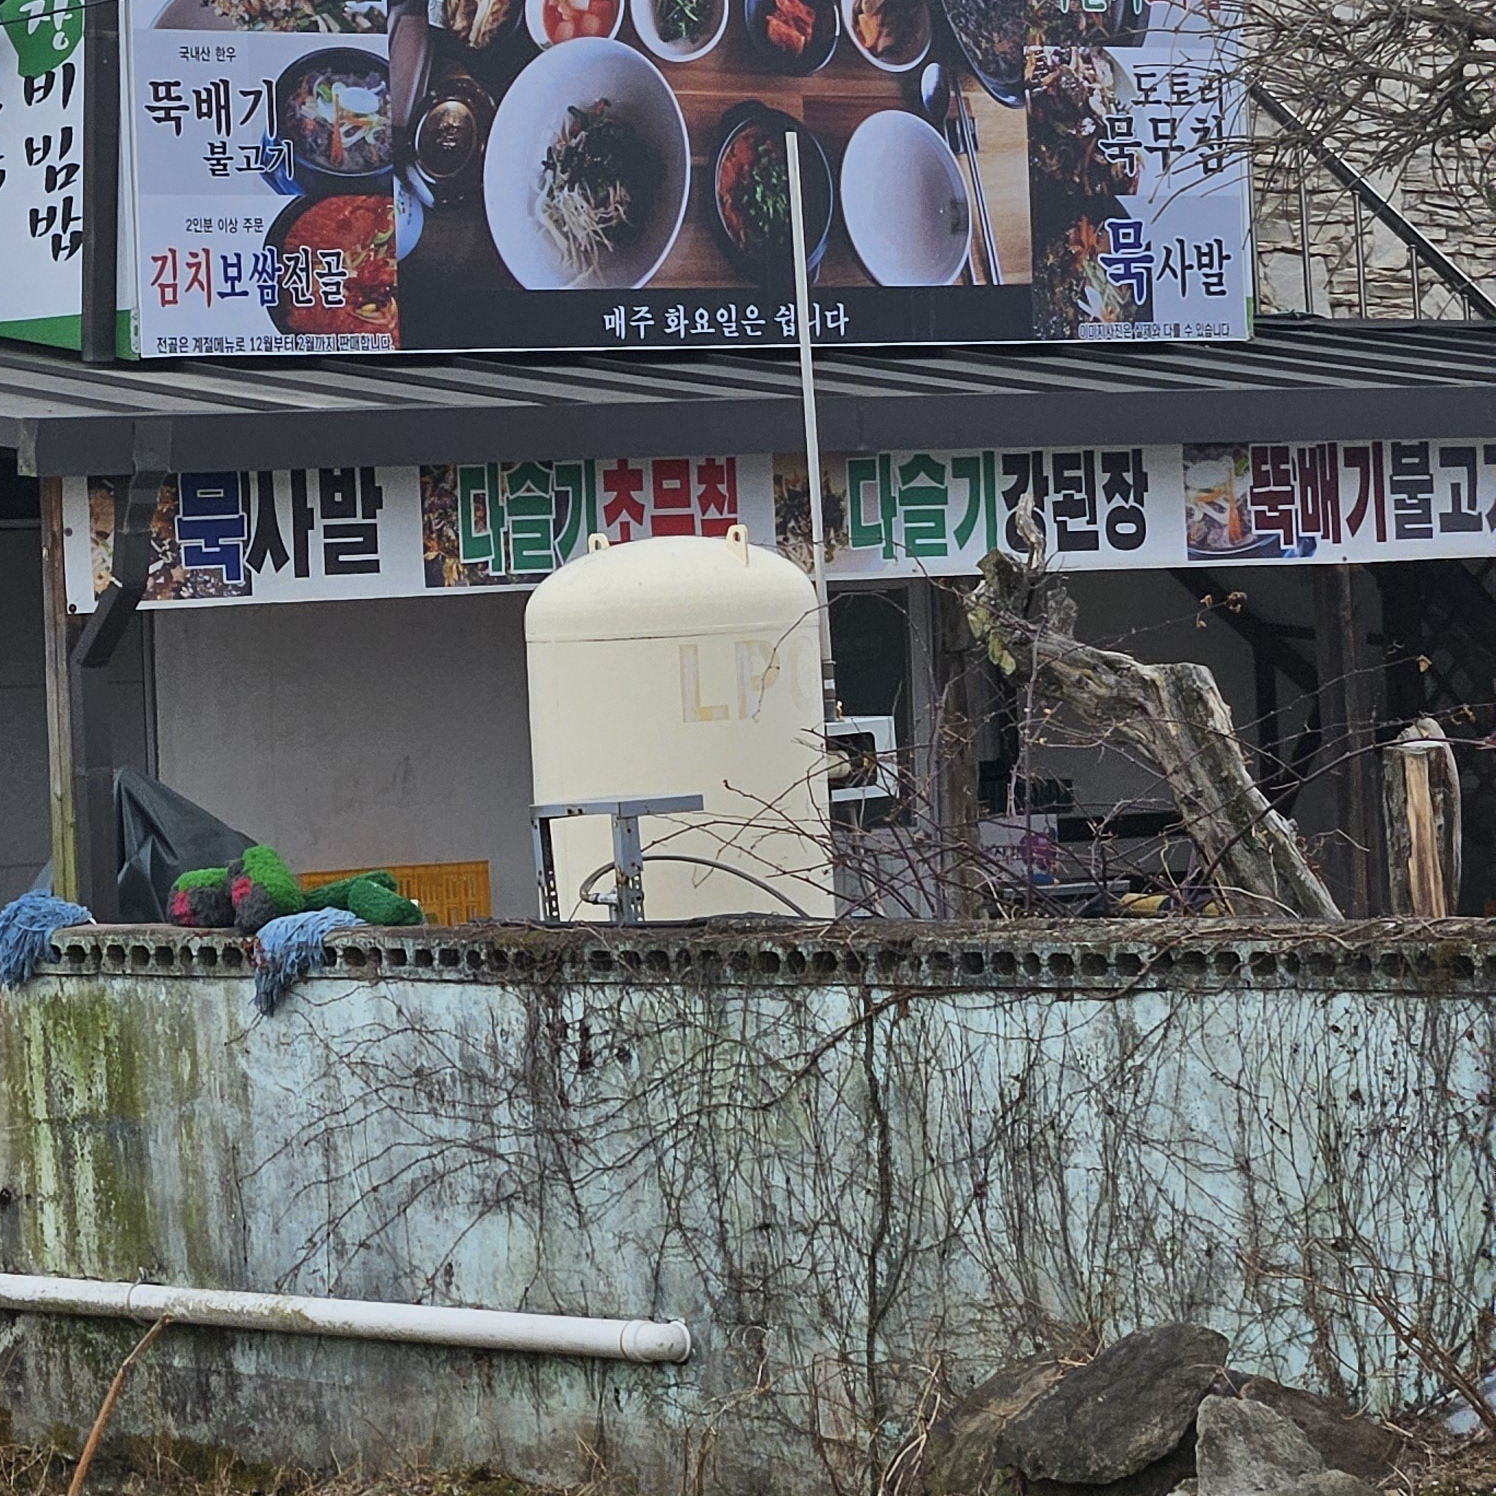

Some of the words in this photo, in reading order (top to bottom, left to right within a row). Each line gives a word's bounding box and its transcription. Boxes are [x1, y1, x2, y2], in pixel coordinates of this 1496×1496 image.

[178, 46, 210, 61] 국내산
[215, 46, 237, 62] 한우
[144, 78, 278, 138] 뚝배기
[203, 140, 295, 179] 불고기
[186, 218, 214, 234] 2인분
[218, 217, 238, 233] 이상
[243, 218, 264, 234] 주문
[603, 304, 655, 340] 매주
[664, 304, 766, 339] 화요일은
[156, 337, 189, 354] 전골은
[192, 337, 245, 354] 계절메뉴로
